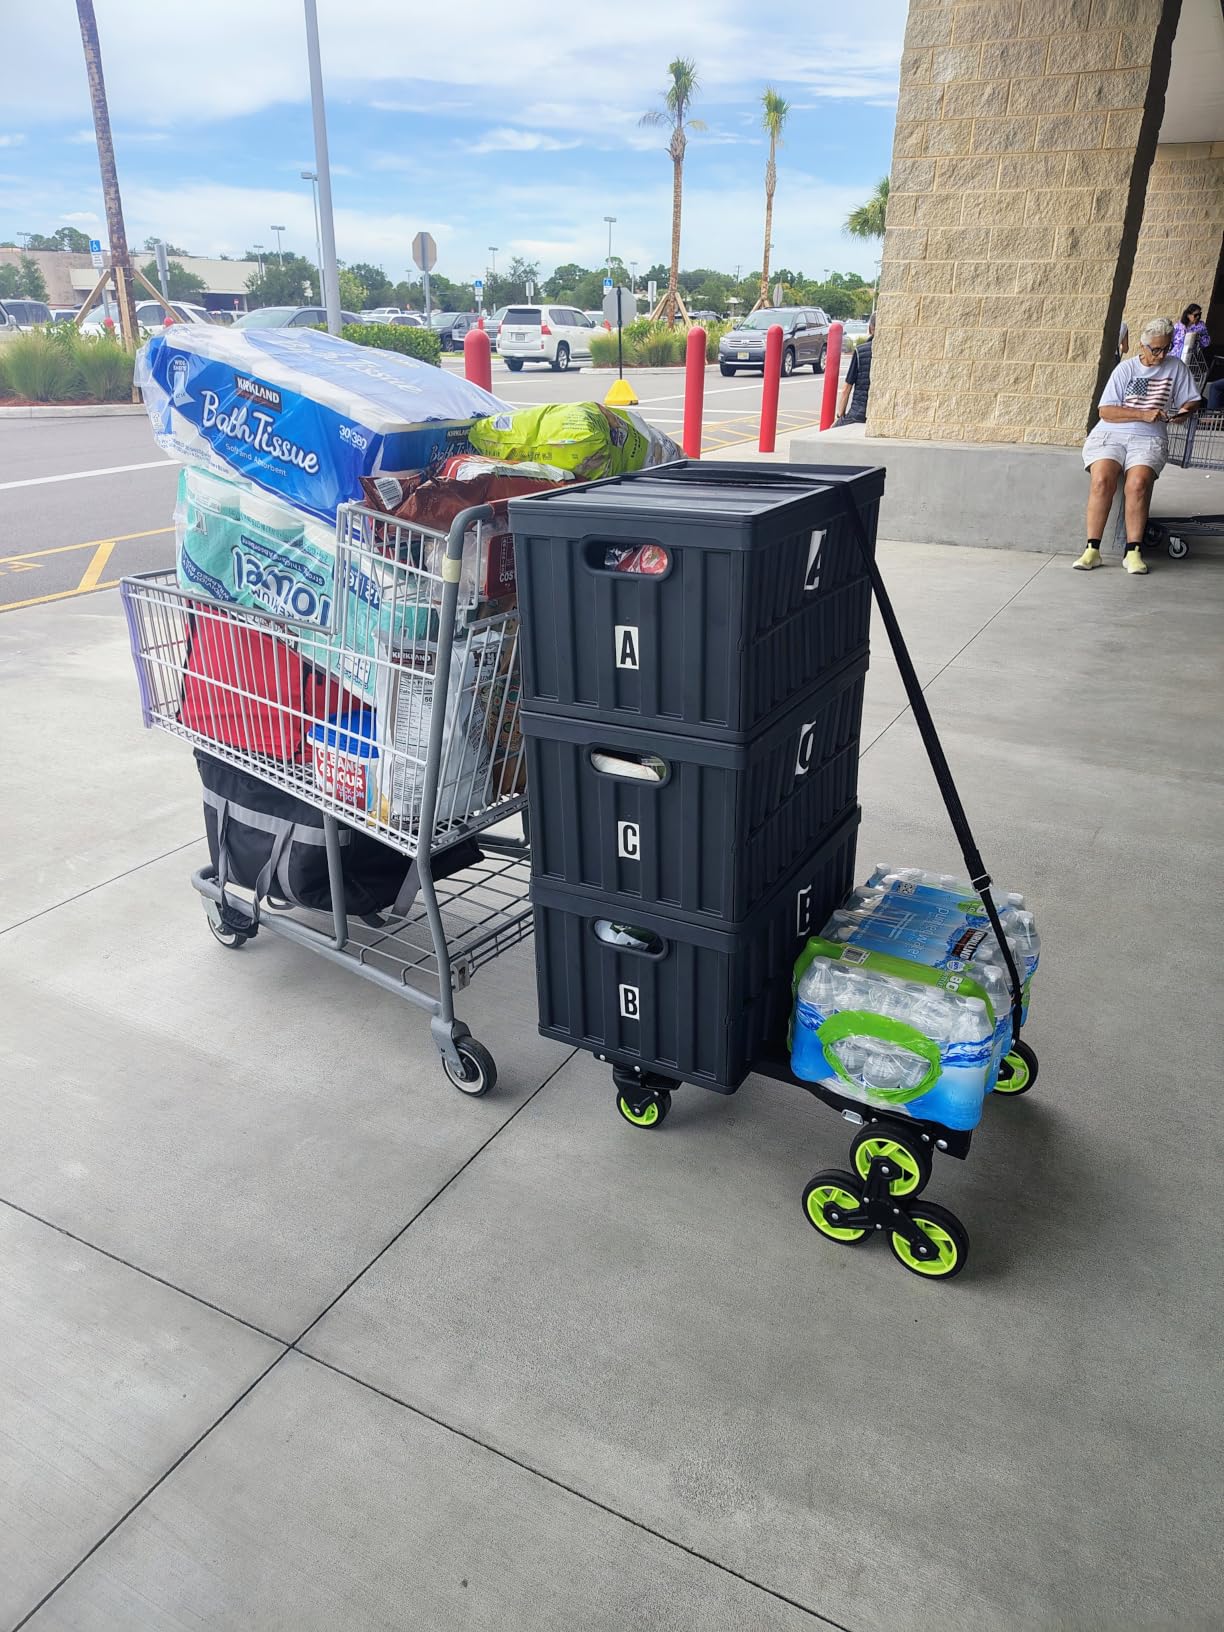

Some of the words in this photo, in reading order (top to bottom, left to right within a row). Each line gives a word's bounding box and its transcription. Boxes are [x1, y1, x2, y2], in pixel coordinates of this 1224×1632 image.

[237, 377, 281, 404] KIRKLAND
[201, 390, 254, 442] Bath
[253, 411, 319, 474] Tissue
[339, 424, 351, 439] 30
[351, 431, 367, 450] 380
[618, 628, 639, 668] A
[621, 823, 639, 858] C
[960, 929, 985, 960] KIRKLAND
[622, 986, 639, 1018] B
